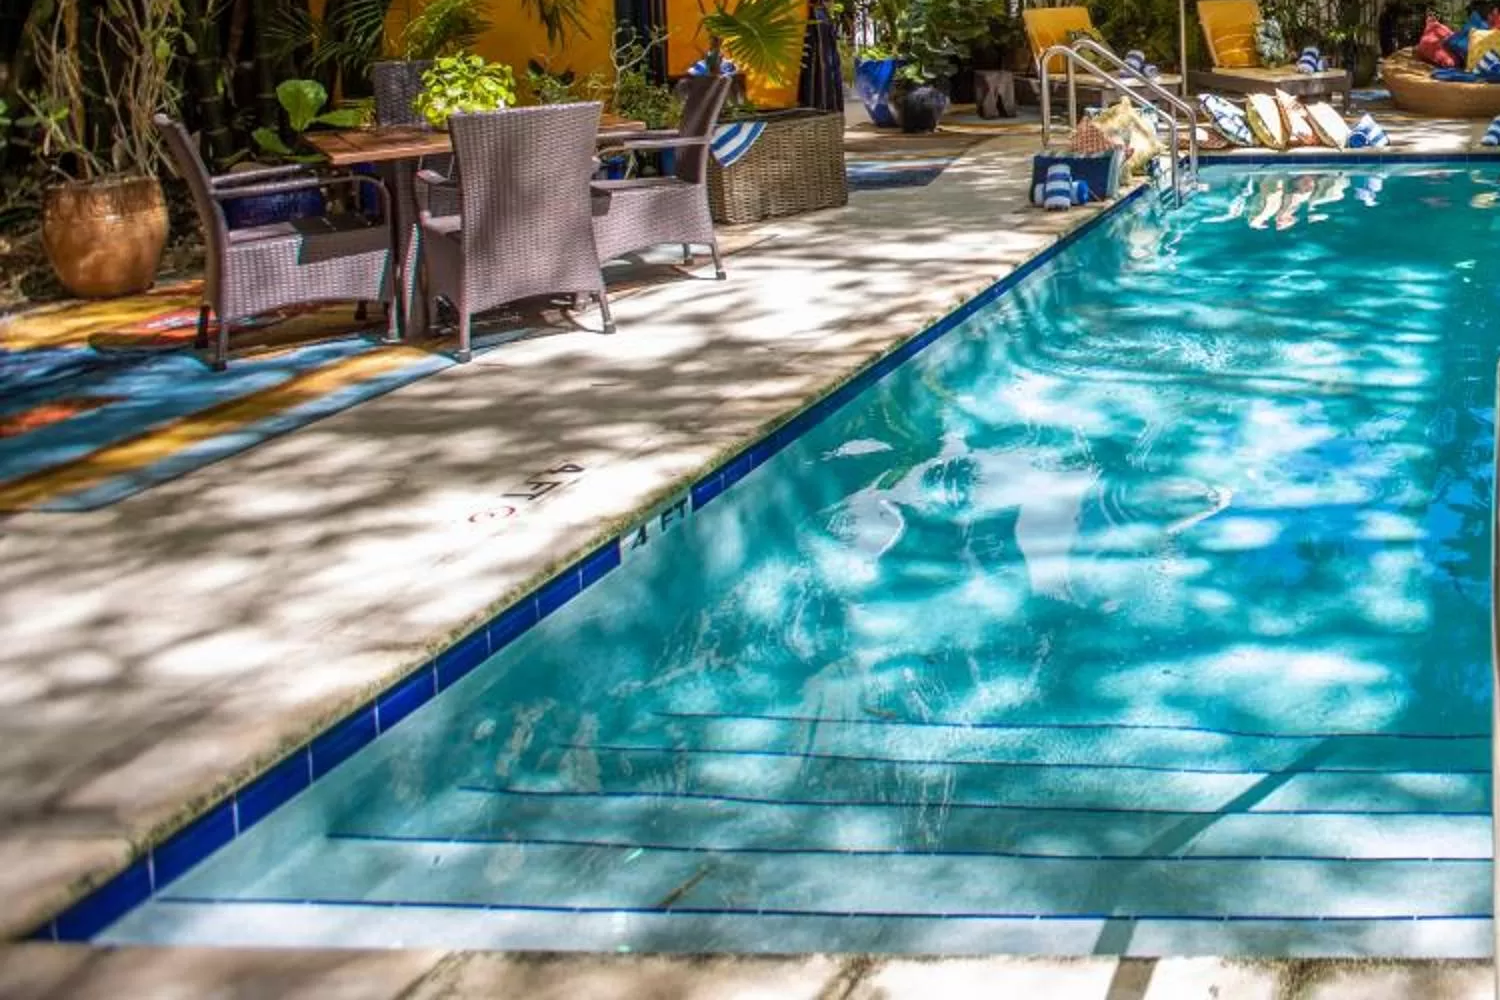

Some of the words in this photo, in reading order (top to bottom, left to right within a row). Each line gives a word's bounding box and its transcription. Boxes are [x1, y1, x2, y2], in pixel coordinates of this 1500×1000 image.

[502, 481, 562, 501] FT
[631, 524, 649, 550] 4
[659, 499, 688, 532] FT
